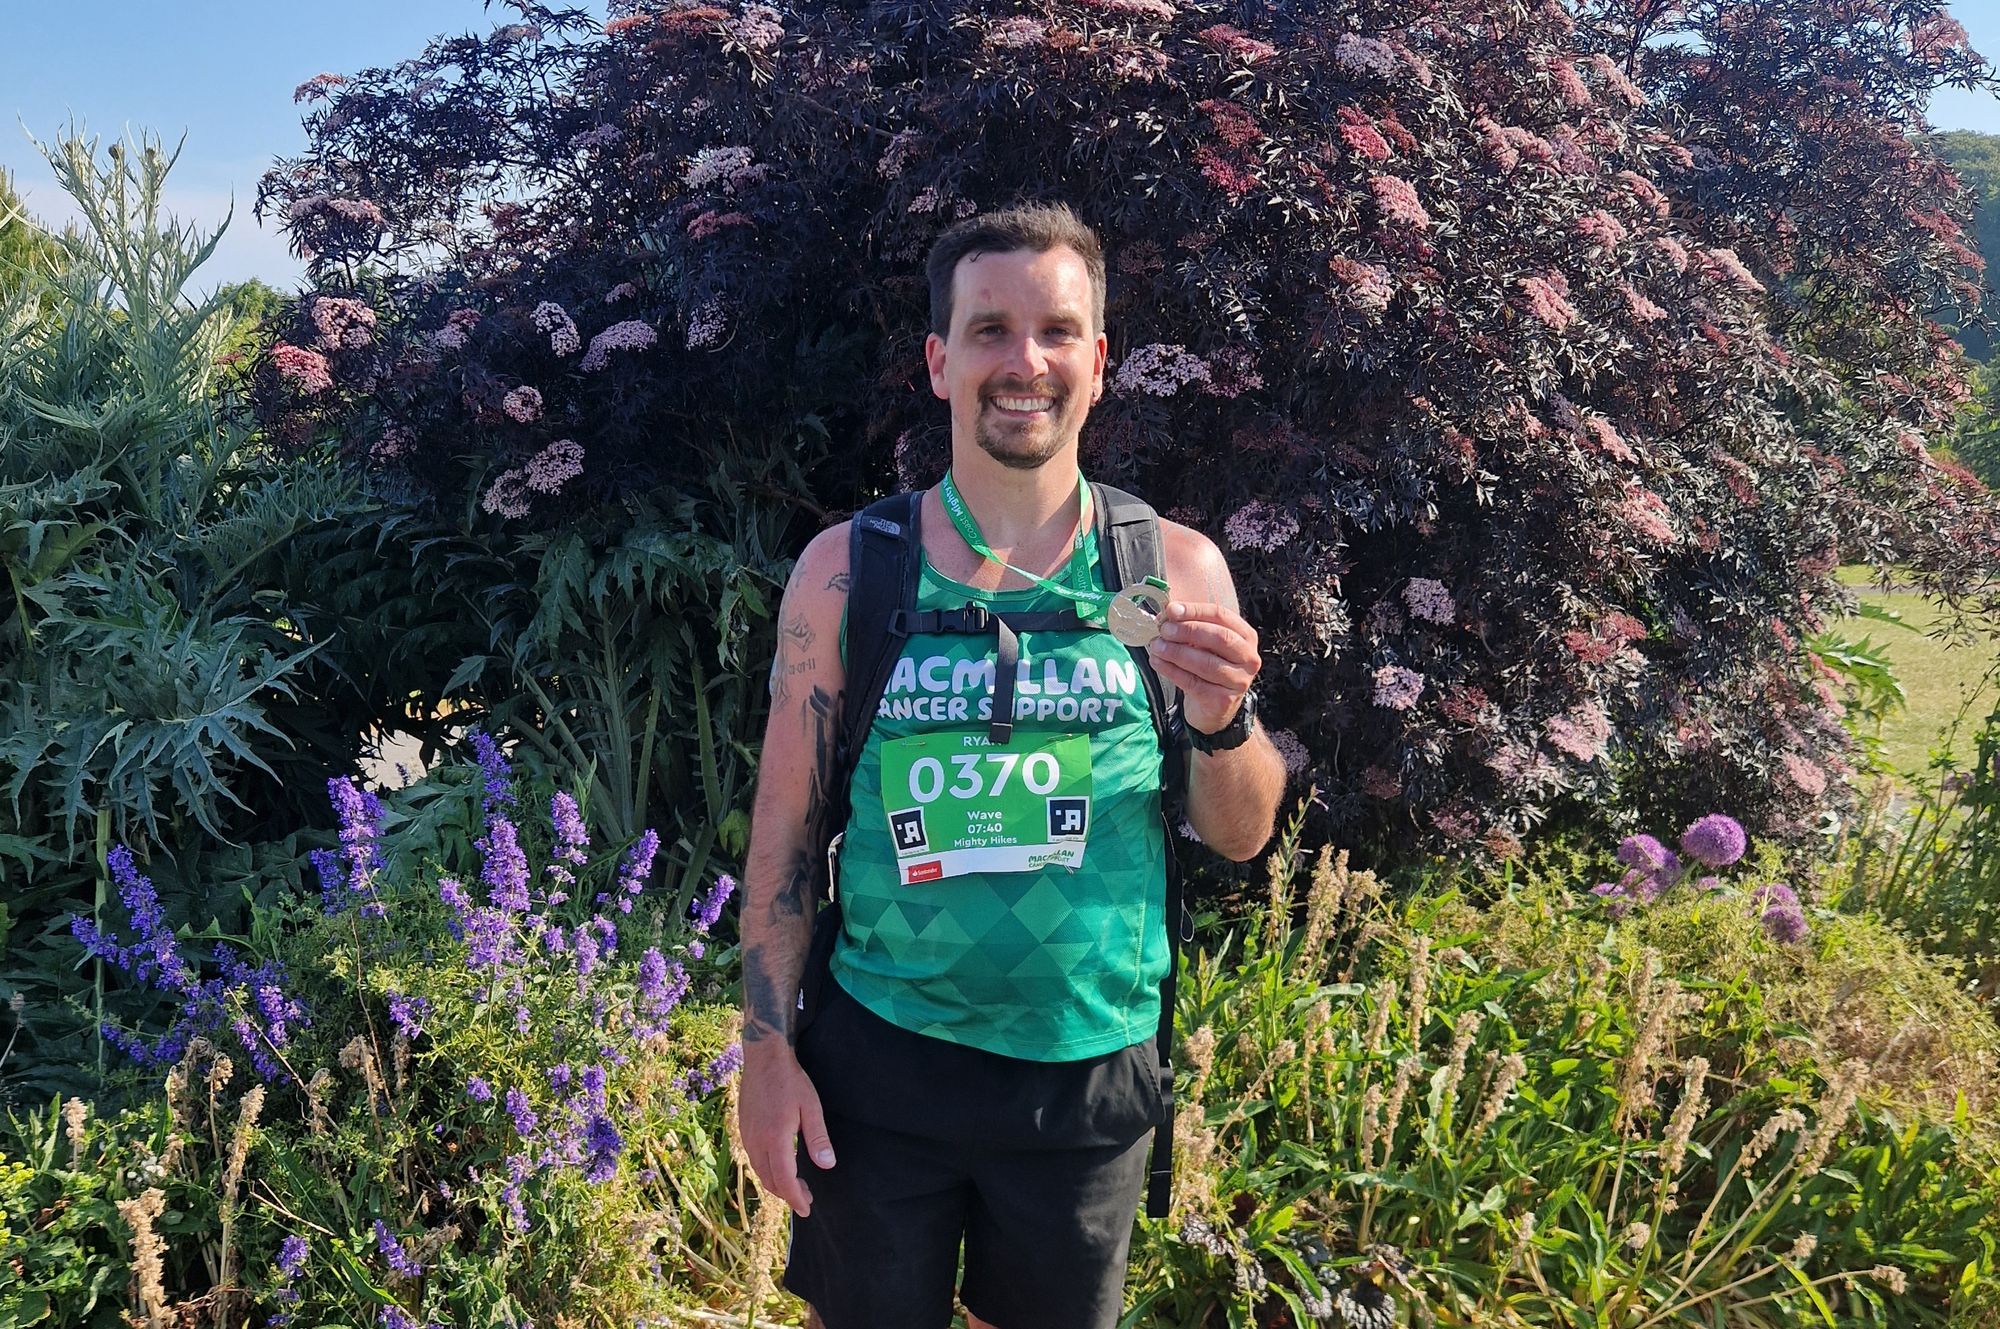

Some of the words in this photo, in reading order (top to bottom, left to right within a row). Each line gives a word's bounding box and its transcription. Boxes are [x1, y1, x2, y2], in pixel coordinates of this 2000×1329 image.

[944, 486, 964, 517] Mighty
[883, 656, 1137, 695] ACMLLAN
[877, 696, 968, 722] ANCER
[977, 696, 1123, 723] SPPORT
[963, 736, 1002, 747] RYA
[908, 752, 1060, 803] 0370
[967, 810, 1002, 821] Wave
[968, 823, 1003, 834] 07:40
[954, 837, 987, 848] Mighty
[990, 836, 1017, 845] Hikes
